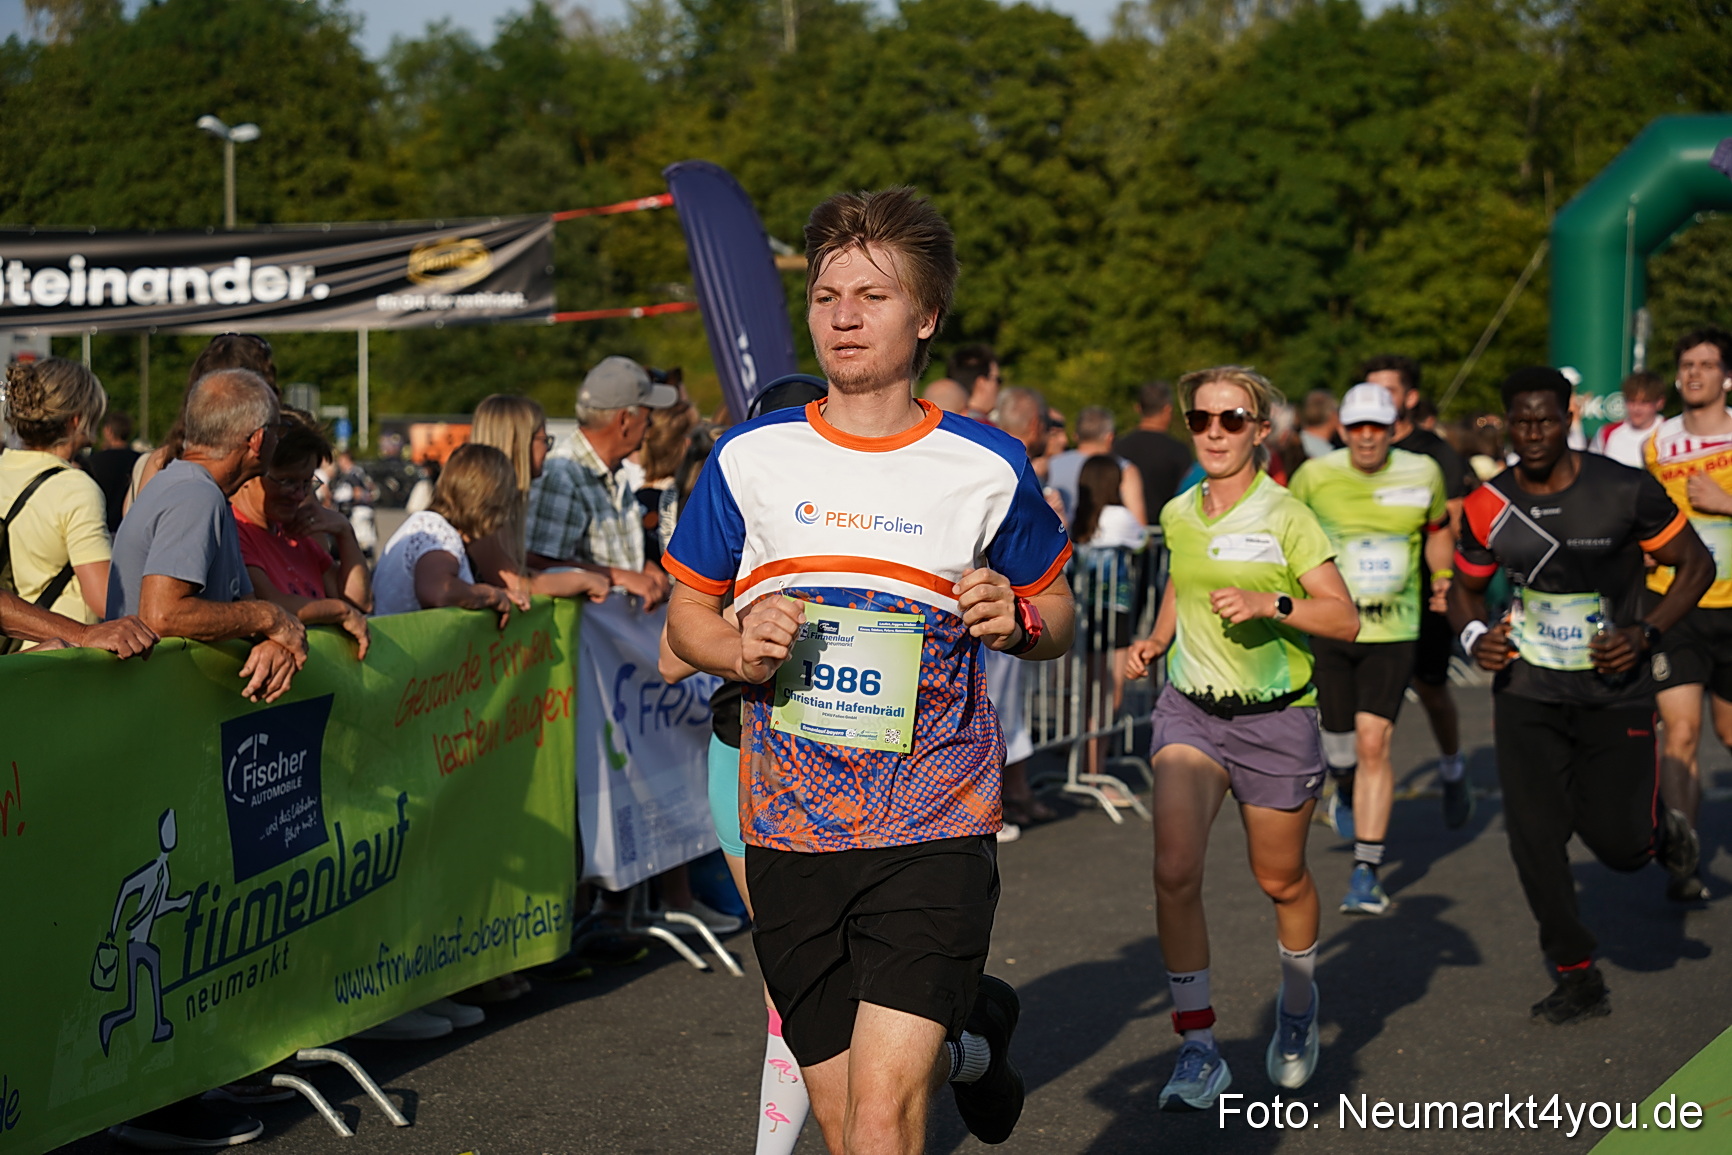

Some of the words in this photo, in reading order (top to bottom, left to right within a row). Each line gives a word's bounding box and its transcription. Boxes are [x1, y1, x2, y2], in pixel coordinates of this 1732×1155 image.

[0, 254, 330, 306] teinander.
[1705, 453, 1732, 472] BÖ
[825, 511, 923, 535] PEKUFolien
[395, 641, 483, 728] Gesunde
[802, 659, 882, 696] 1986
[784, 687, 833, 710] Christian
[836, 700, 905, 718] Hafenbrädl
[433, 708, 499, 777] laufen
[243, 749, 307, 793] Fischer
[251, 775, 302, 807] AUTOMOBILE
[183, 791, 410, 980] firmenlauf
[186, 941, 289, 1022] neumarkt
